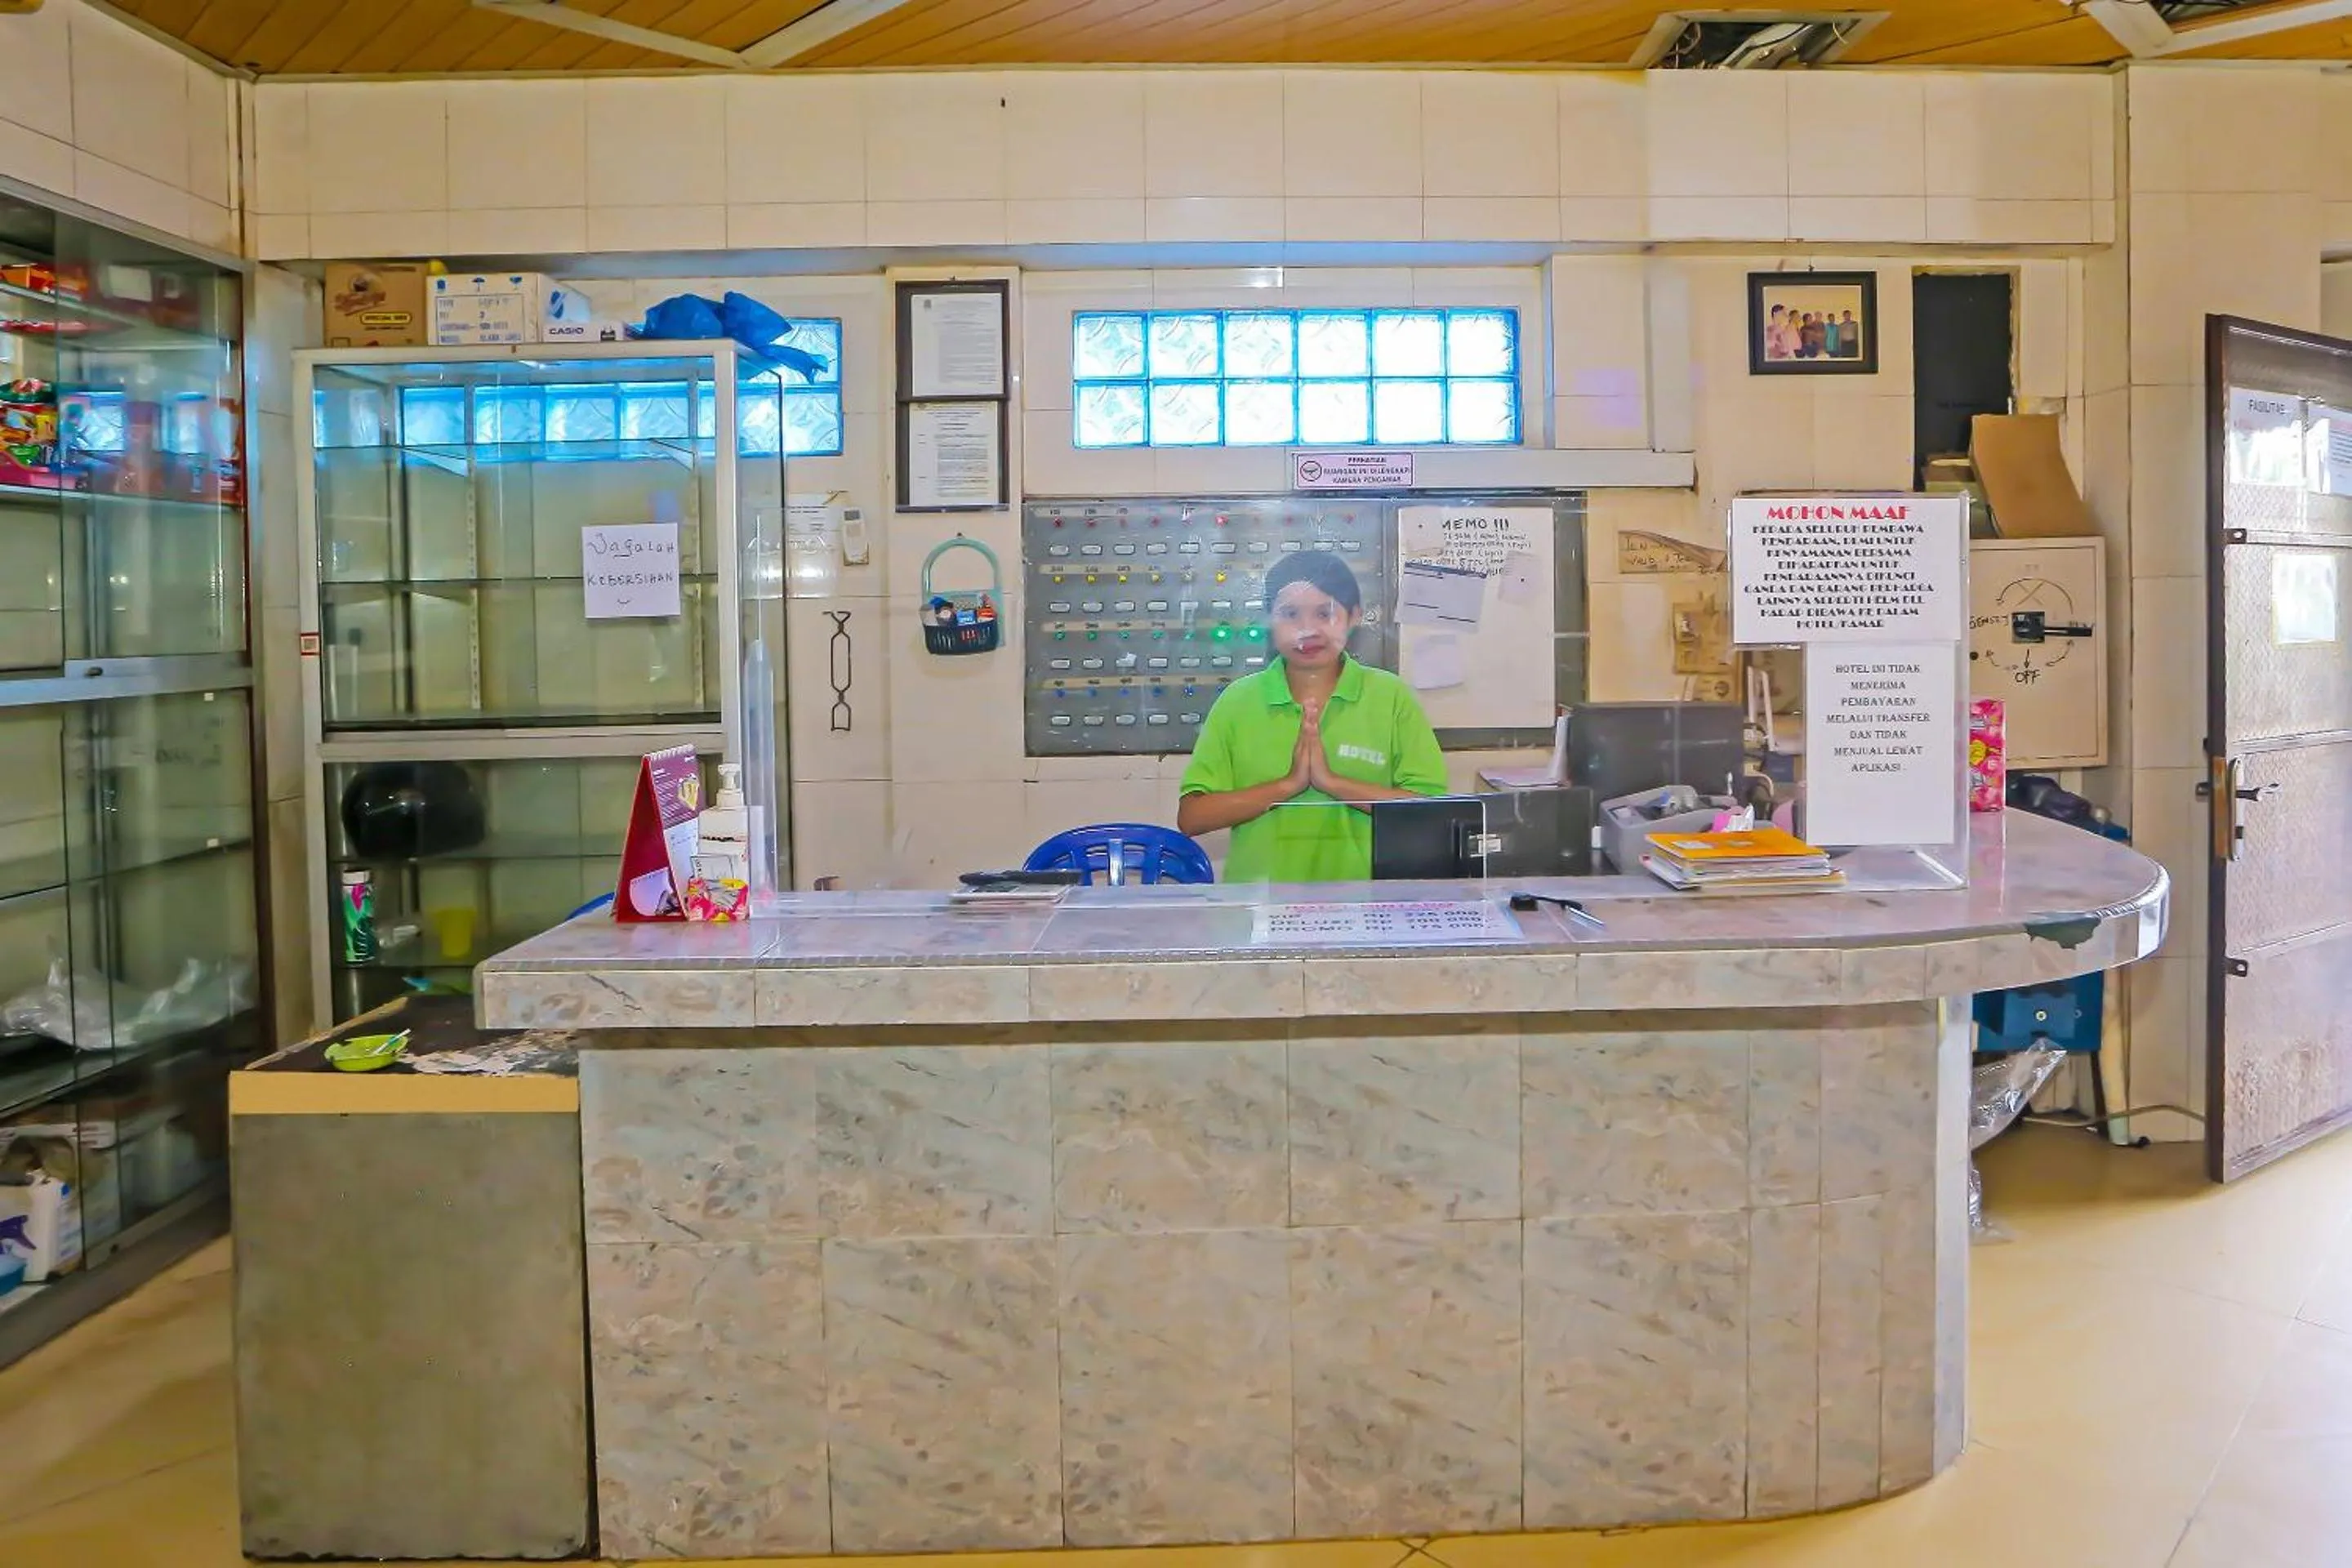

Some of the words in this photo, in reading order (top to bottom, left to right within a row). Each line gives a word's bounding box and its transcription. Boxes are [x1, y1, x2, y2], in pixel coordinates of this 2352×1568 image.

[549, 327, 585, 335] CASIO
[1767, 506, 1845, 519] MOHON
[1850, 506, 1912, 519] MAAF
[1442, 518, 1487, 531] MEMO
[1752, 525, 1803, 534] KEPADA
[1805, 524, 1860, 534] SELURUH
[1863, 524, 1925, 533] PEMBAWA
[1876, 537, 1915, 546] UNTUK
[1766, 549, 1852, 557] KENYAMANAN
[1854, 548, 1912, 557] BERSAMA
[1777, 561, 1859, 569] DIHARAPKAN
[1860, 560, 1902, 568] UNTUK
[1764, 572, 1864, 581] KENDARAANNYA
[1866, 571, 1915, 581] DIKUNCI
[1744, 584, 1787, 594] GANDA
[1788, 584, 1815, 593] DAN
[1817, 584, 1867, 593] BARANG
[1869, 582, 1935, 592] BERHARGA
[1757, 597, 1811, 605] LAINNYA
[1813, 596, 1864, 604] SEPERTI
[1760, 608, 1804, 617] HARAP
[1806, 608, 1855, 617] DIBAWA
[1858, 608, 1875, 616] KE
[1876, 608, 1920, 616] DALAM
[1835, 664, 1870, 674] HOTEL
[1872, 665, 1886, 673] INI
[1887, 664, 1921, 673] TIDAK
[2014, 669, 2042, 684] OFF
[1849, 680, 1907, 690] MENERIMA
[1841, 696, 1917, 706] PEMBAYARAN
[1825, 714, 1873, 724] MELALUI
[1875, 712, 1931, 722] TRANSFER
[1849, 730, 1872, 739] DAN
[1874, 729, 1908, 739] TIDAK
[1833, 746, 1884, 756] MENJUAL
[1886, 745, 1924, 755] LEWAT
